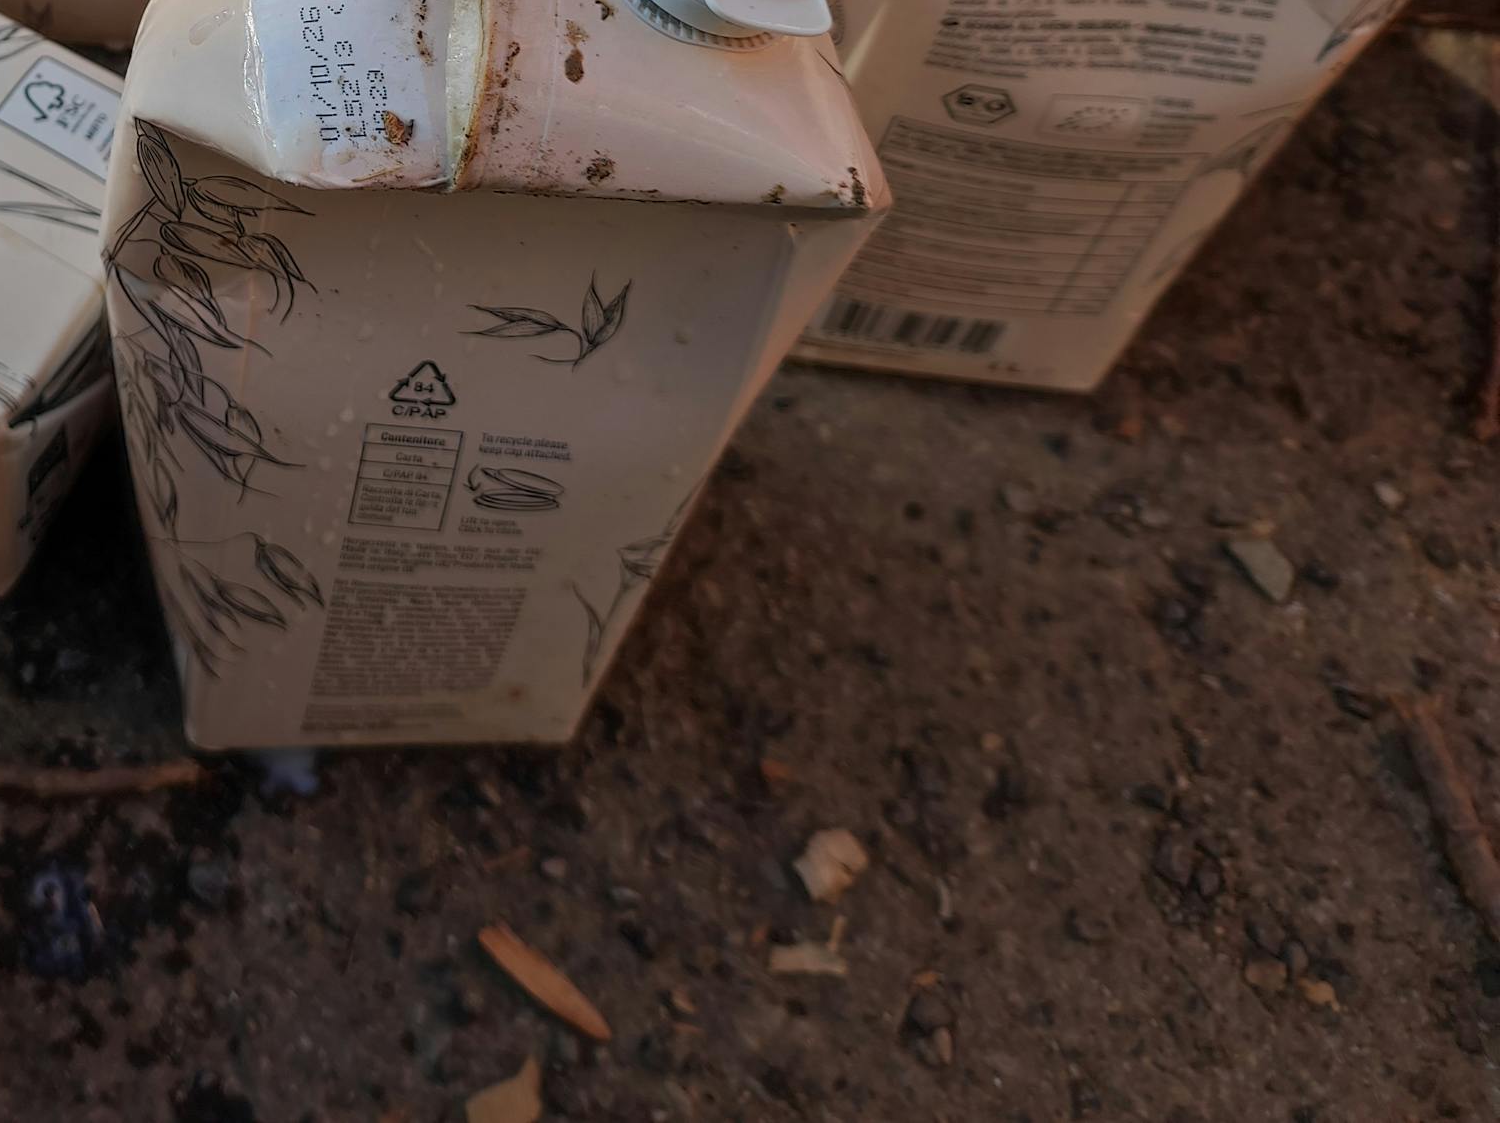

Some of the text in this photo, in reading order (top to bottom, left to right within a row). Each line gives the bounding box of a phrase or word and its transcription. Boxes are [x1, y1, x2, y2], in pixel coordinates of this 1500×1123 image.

[300, 6, 340, 141] 01/10/26
[334, 40, 367, 138] L5213
[392, 405, 446, 420] C/PAP
[414, 381, 435, 394] 84
